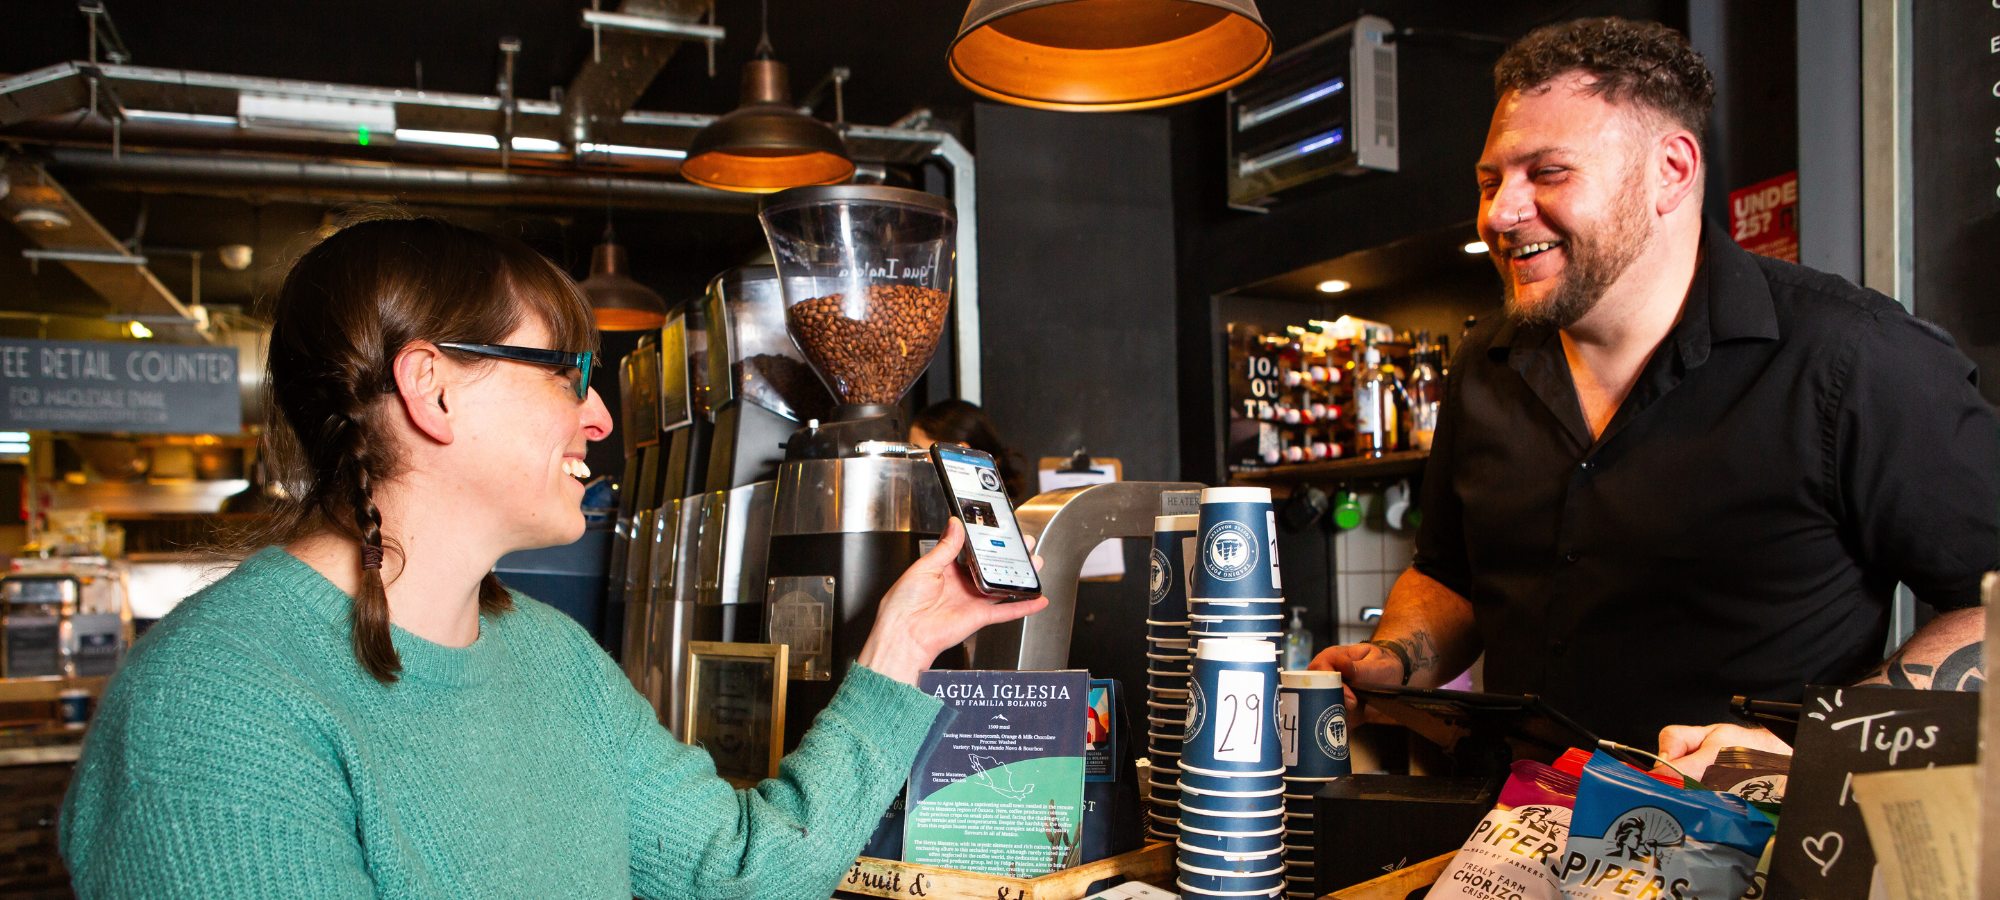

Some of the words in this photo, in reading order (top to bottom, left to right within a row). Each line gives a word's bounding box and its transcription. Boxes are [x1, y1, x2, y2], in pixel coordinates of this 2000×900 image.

[1734, 180, 1797, 218] UNDE
[1734, 212, 1772, 242] 25?
[0, 346, 30, 378] EE
[40, 348, 118, 380] RETAIL
[126, 350, 234, 384] COUNTER
[10, 386, 40, 406] FOR
[1168, 496, 1200, 506] HEATER
[1210, 524, 1232, 539] ROASTERS
[1234, 525, 1251, 540] COFFEE
[1209, 564, 1222, 576] POST
[1223, 564, 1250, 578] TRADING
[934, 684, 985, 698] AGUA
[992, 684, 1070, 700] IGLESIA
[1218, 694, 1260, 752] 29
[1283, 713, 1297, 753] 4
[1323, 745, 1336, 756] POST
[1831, 711, 1940, 766] Tips
[1470, 820, 1564, 878] PIPERS
[1470, 848, 1489, 856] MADE
[1504, 858, 1544, 879] FARMERS
[848, 861, 902, 892] Fruit
[1453, 870, 1522, 900] CHORIZO
[1463, 862, 1495, 878] TREALY
[1497, 875, 1527, 893] FARM
